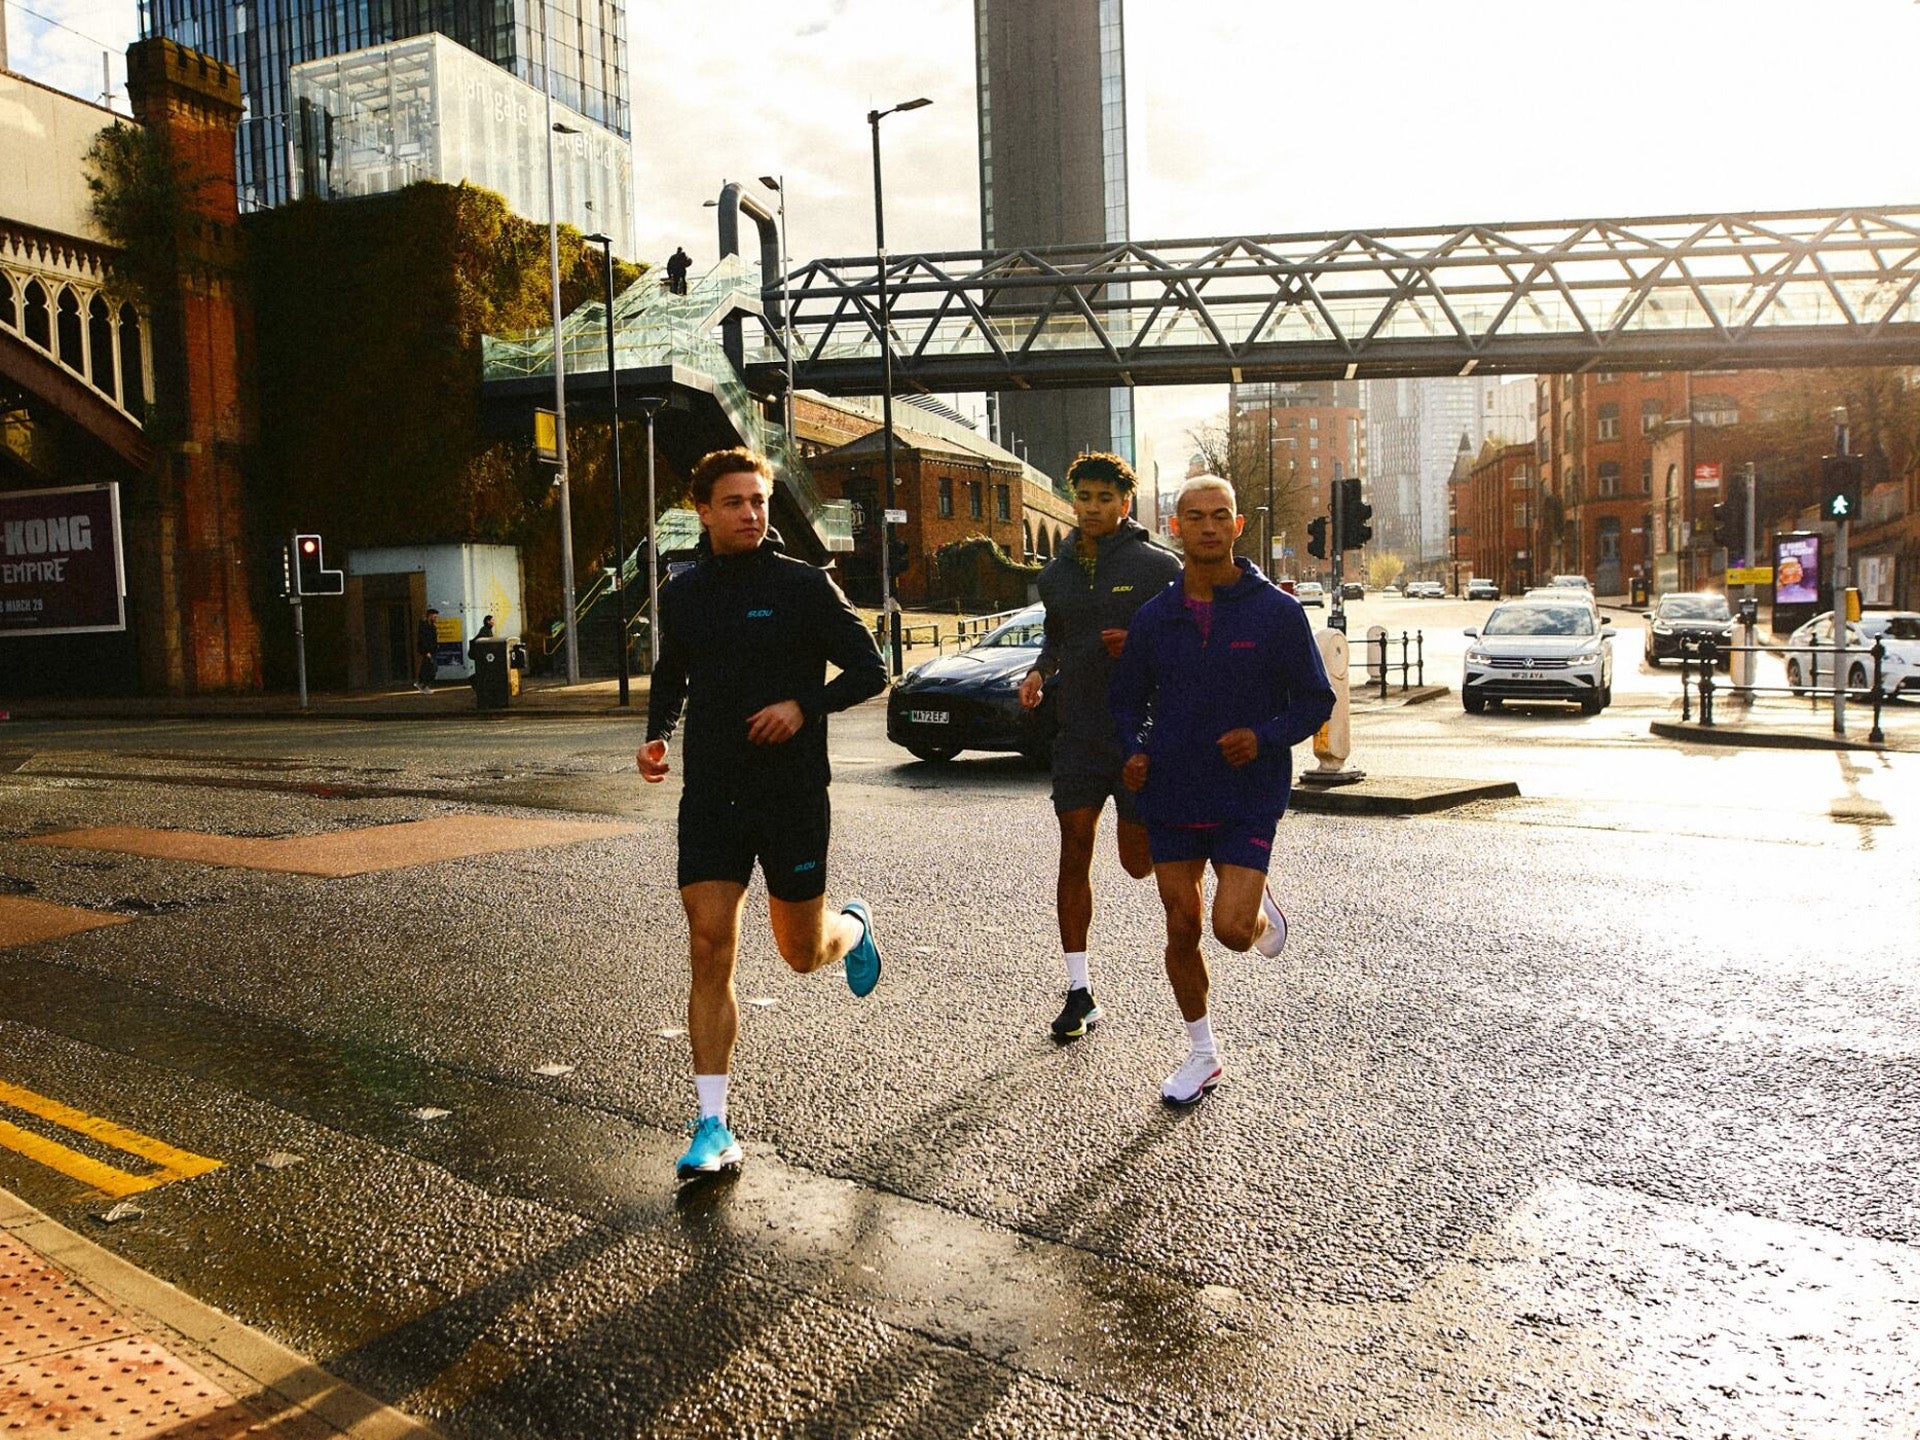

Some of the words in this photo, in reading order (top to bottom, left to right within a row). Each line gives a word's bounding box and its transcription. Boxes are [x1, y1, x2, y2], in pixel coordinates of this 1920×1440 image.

[4, 515, 93, 556] KONG
[1, 557, 70, 584] EMPIRE
[5, 599, 31, 613] MARCH
